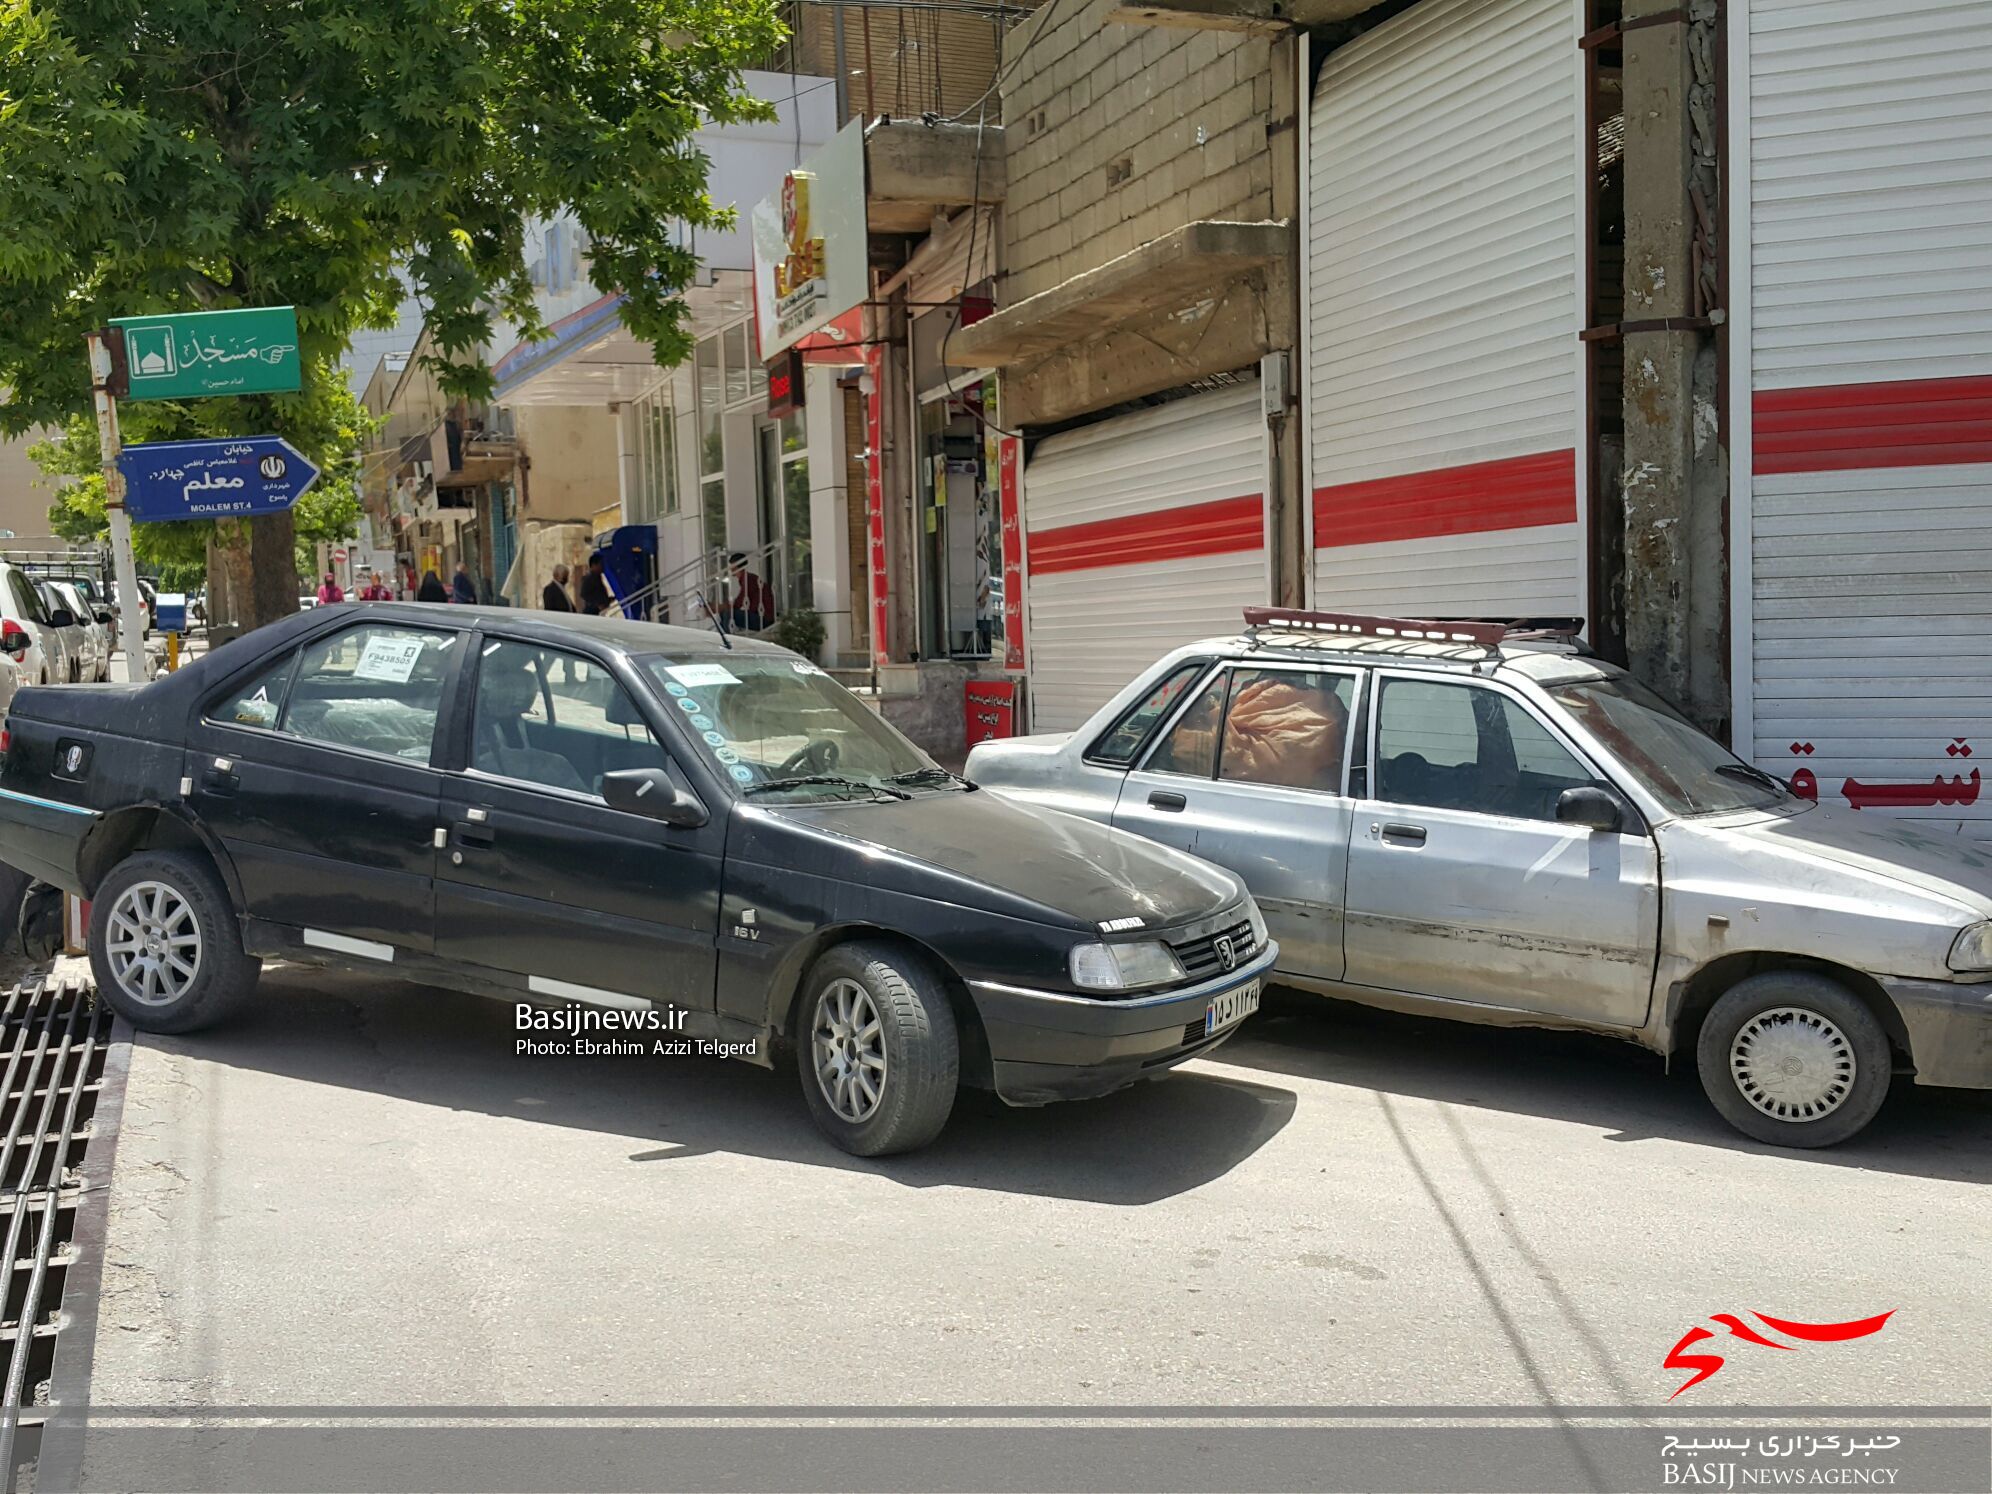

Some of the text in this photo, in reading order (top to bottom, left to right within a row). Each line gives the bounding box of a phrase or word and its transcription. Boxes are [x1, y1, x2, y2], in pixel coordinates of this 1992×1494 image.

[208, 379, 230, 389] حسین
[230, 376, 245, 385] امام
[224, 443, 254, 456] خیابان
[183, 471, 245, 501] معلم
[262, 482, 291, 491] شهرداری
[268, 494, 288, 503] یاسوج
[190, 501, 252, 513] MOALEM ST.4
